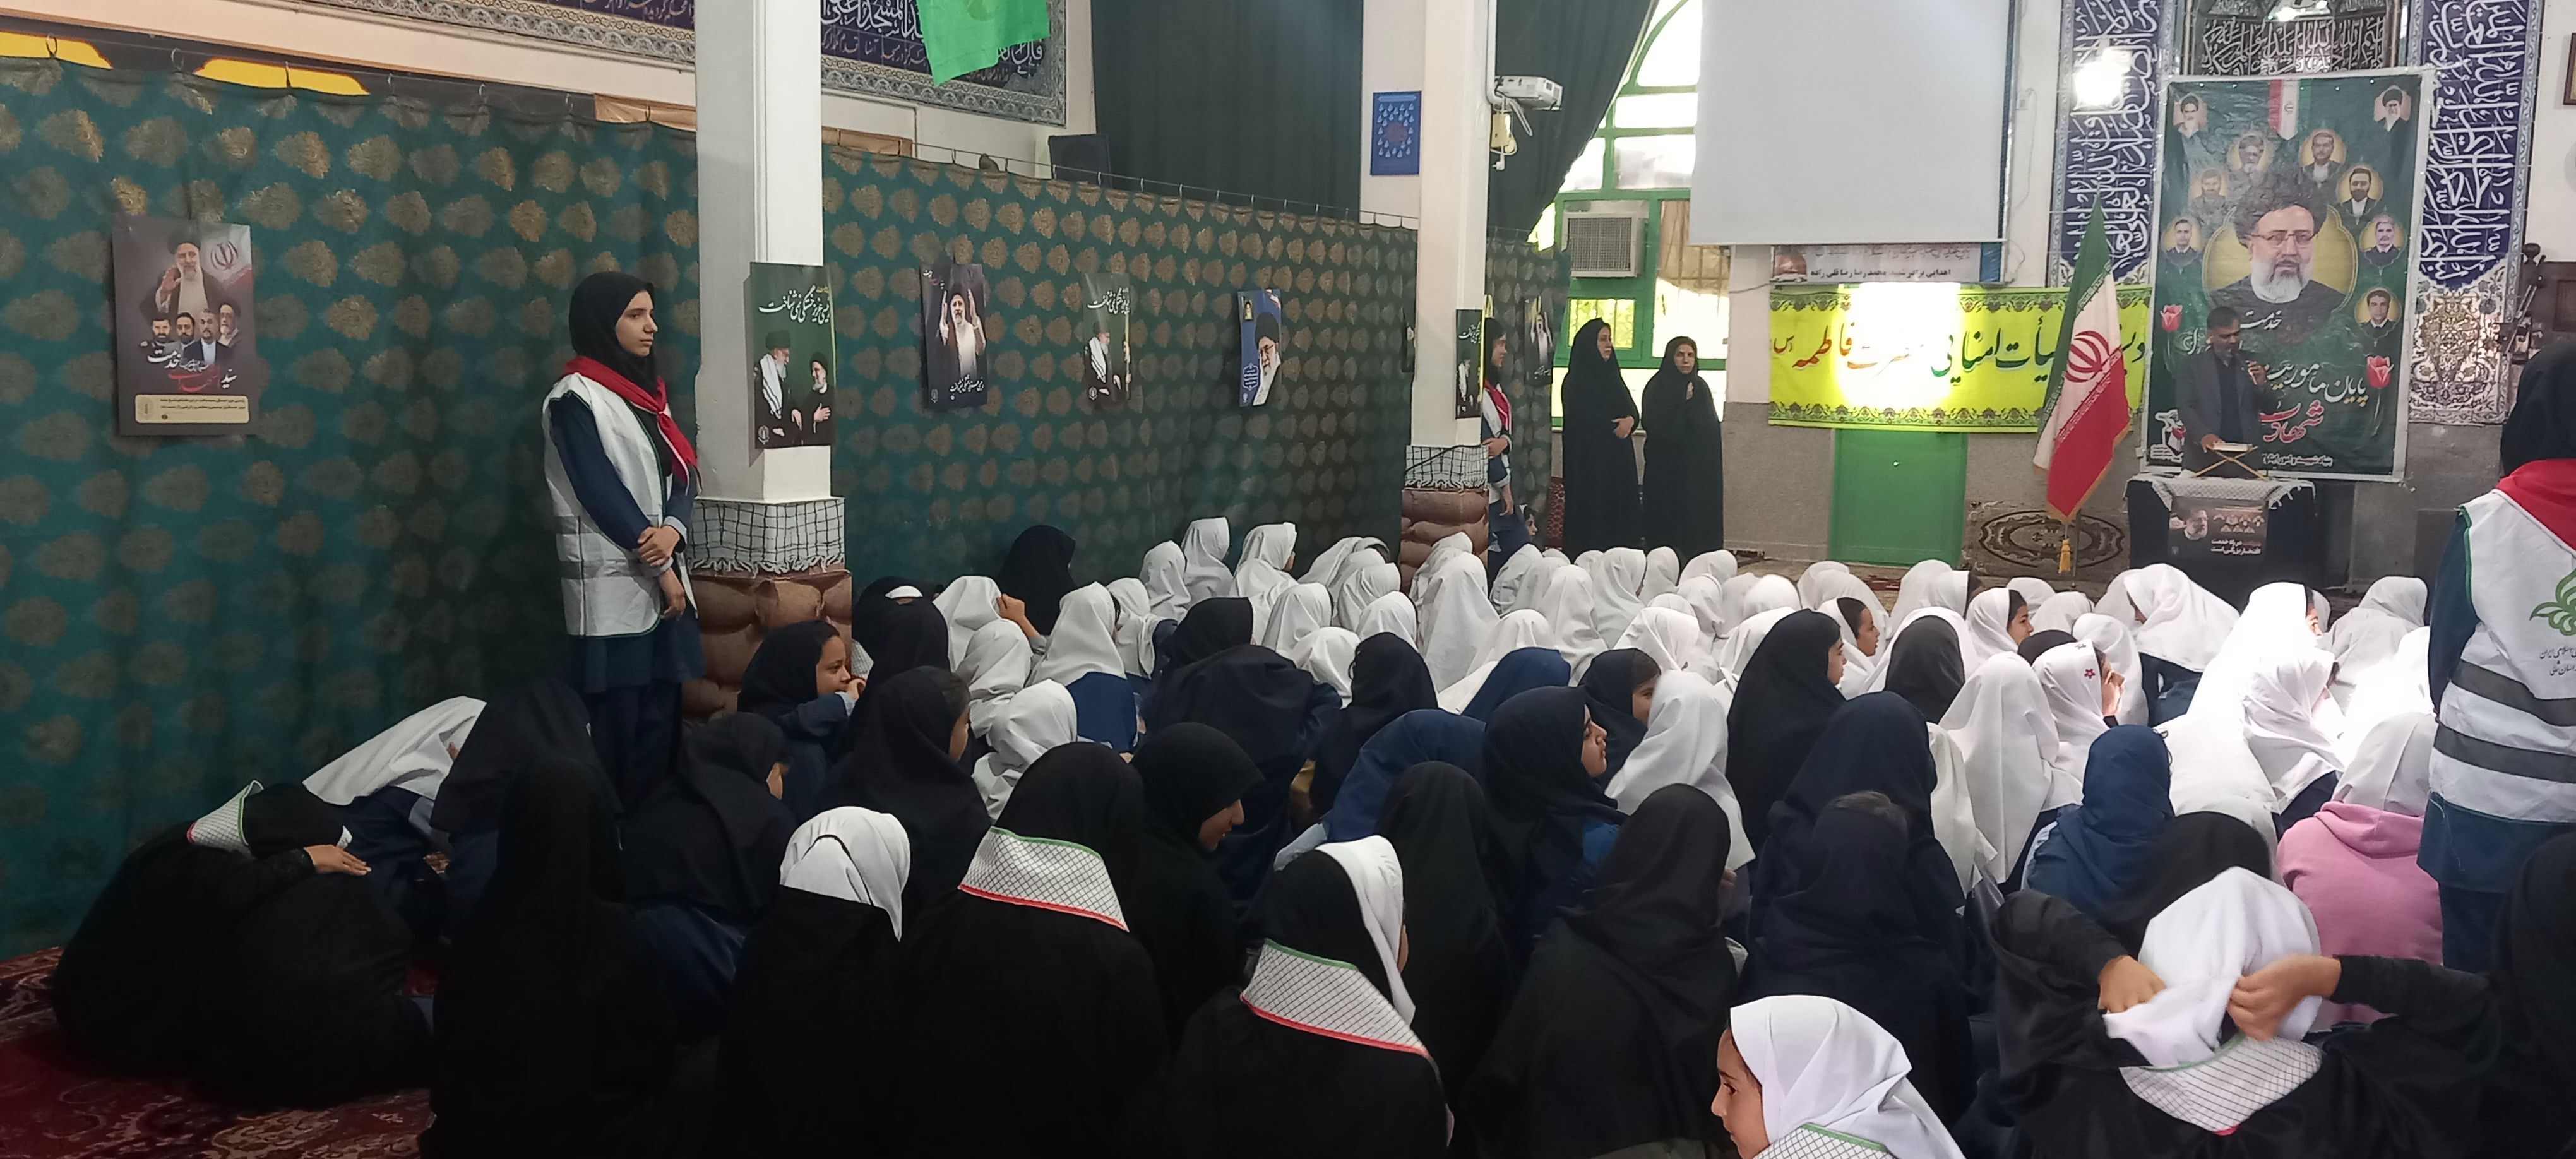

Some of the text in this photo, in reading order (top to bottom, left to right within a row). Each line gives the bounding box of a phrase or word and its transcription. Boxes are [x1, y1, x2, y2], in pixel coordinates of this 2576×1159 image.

[2239, 310, 2283, 331] خدمت
[146, 349, 182, 369] خدمت
[1792, 321, 1856, 371] فاطمه
[2324, 375, 2369, 407] پایان
